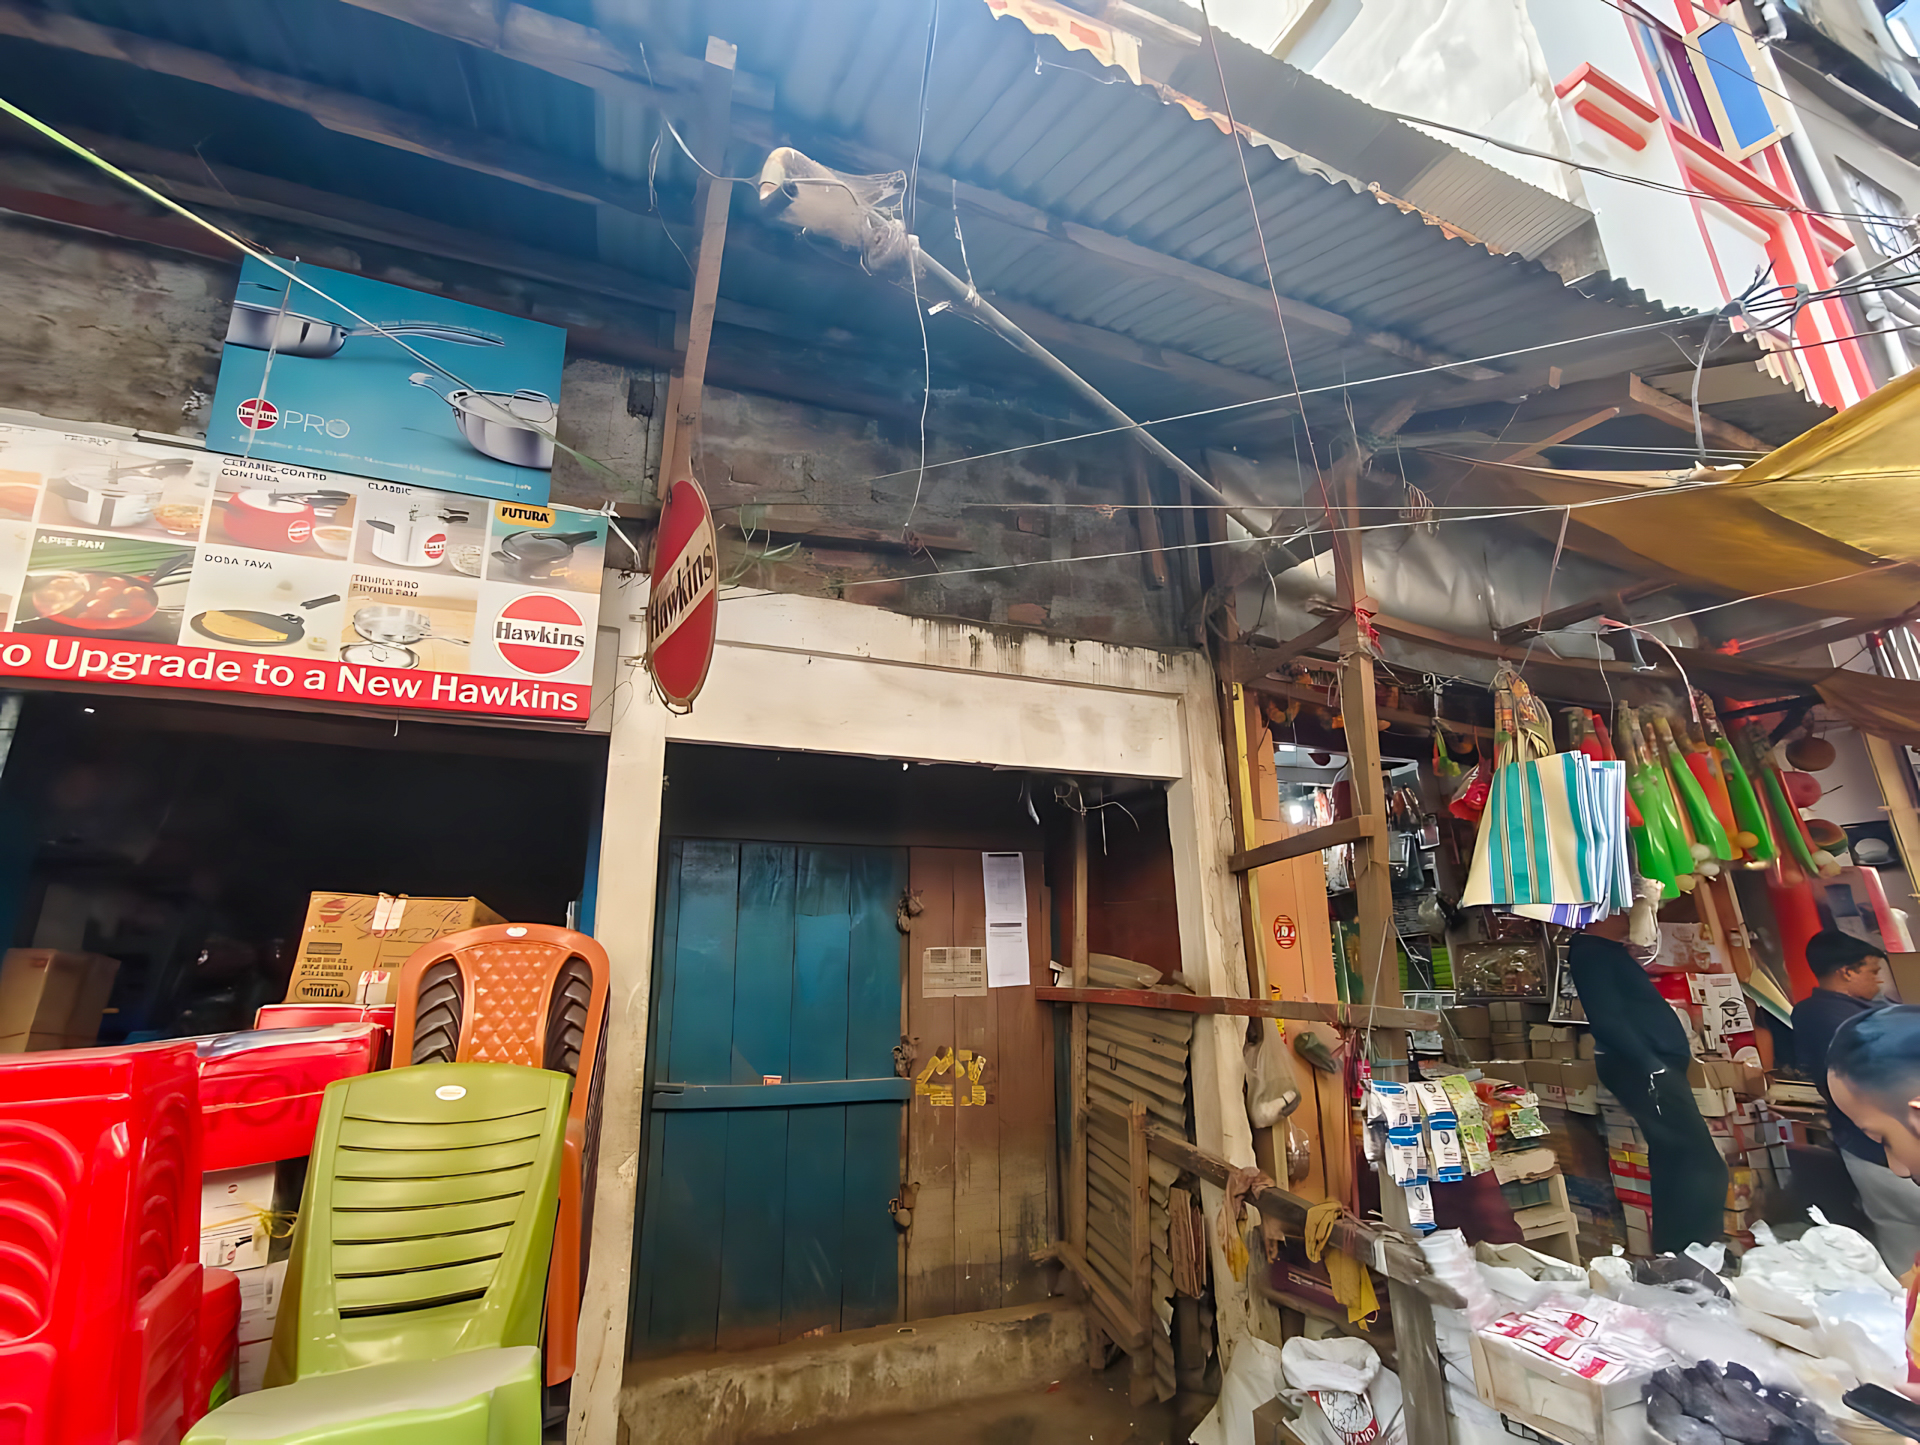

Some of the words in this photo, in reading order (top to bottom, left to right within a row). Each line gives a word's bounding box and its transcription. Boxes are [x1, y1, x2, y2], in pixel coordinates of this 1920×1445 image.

[283, 410, 350, 438] PRO
[501, 506, 550, 524] FUTURA
[77, 540, 106, 550] PAN
[243, 559, 273, 570] TAVA
[650, 543, 714, 643] Hawkins
[495, 621, 585, 648] Hawkins
[45, 638, 242, 681] Upgrade
[253, 658, 295, 687] to
[303, 669, 326, 691] a
[337, 665, 423, 699] New
[431, 674, 579, 712] Hawkins
